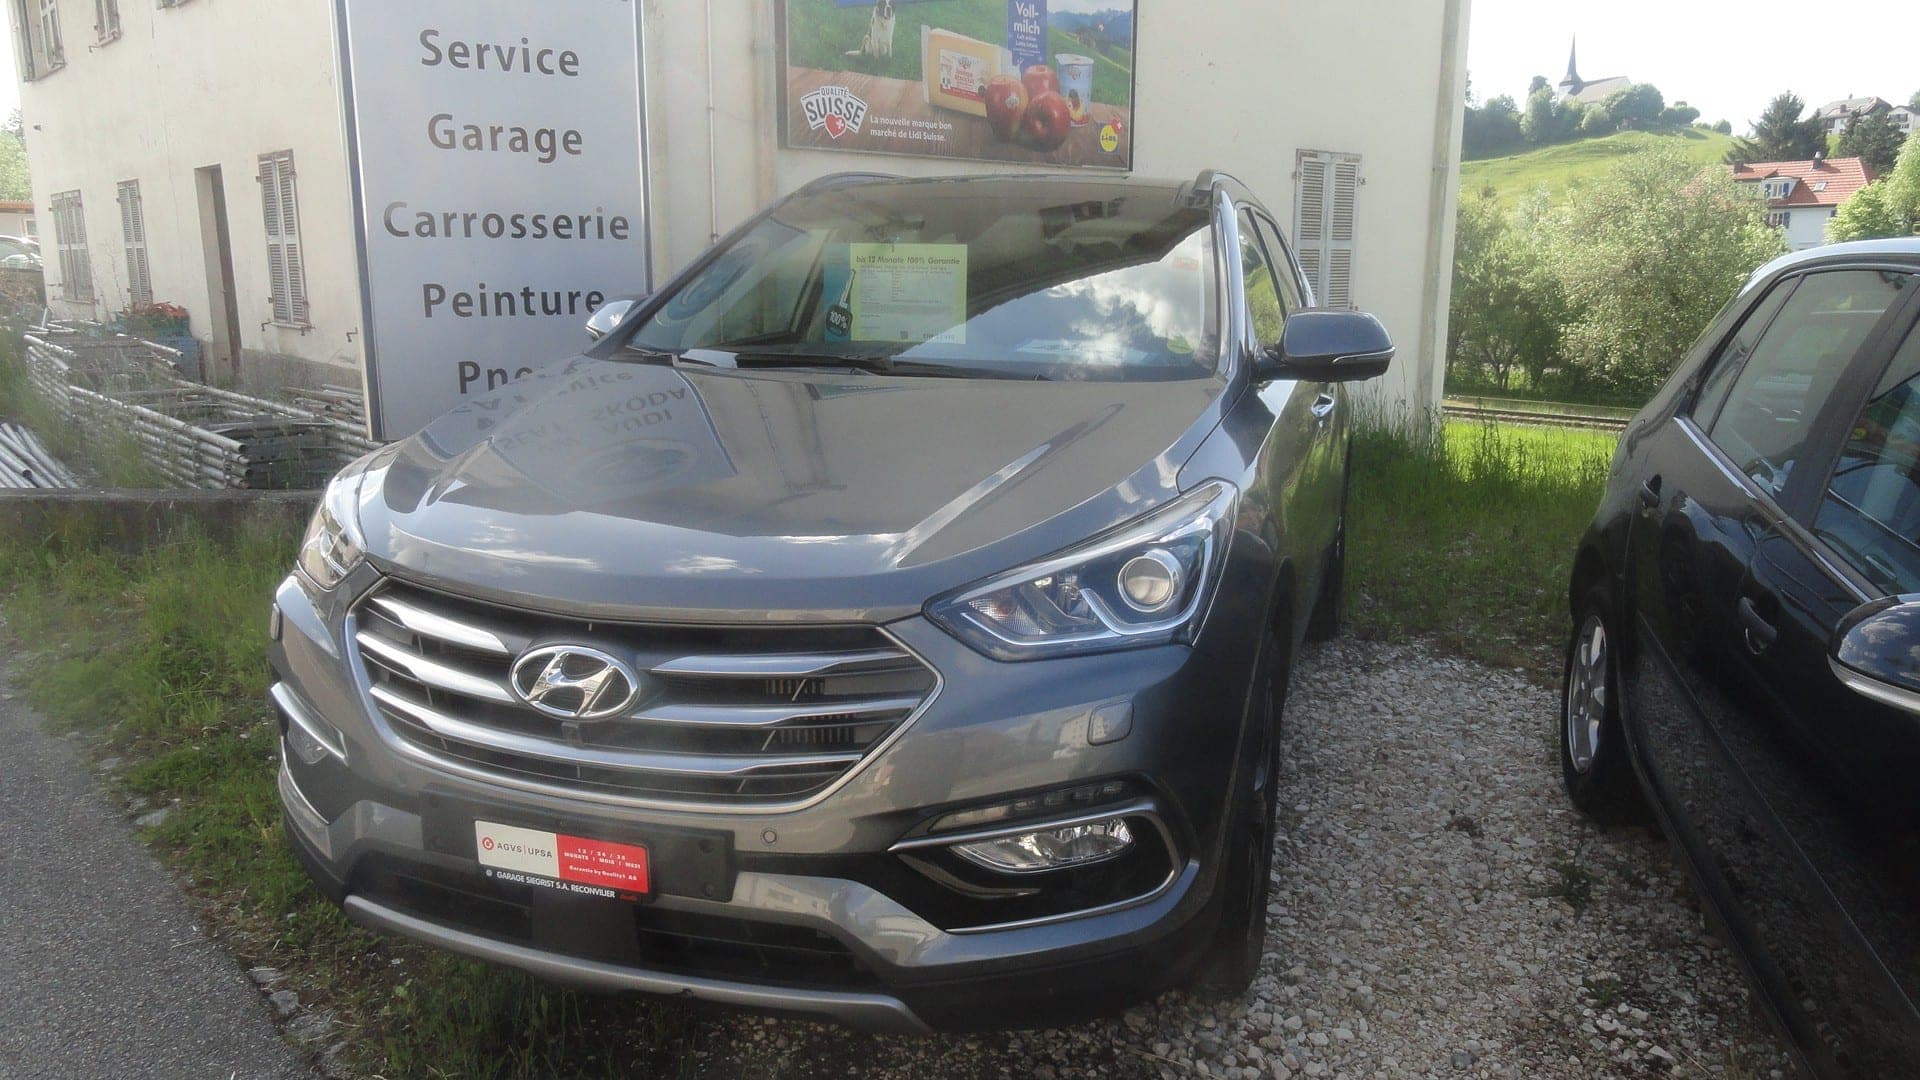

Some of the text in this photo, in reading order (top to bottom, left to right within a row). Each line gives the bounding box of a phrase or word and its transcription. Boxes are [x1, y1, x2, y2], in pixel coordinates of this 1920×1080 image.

[1015, 1, 1040, 19] Voll-
[1013, 18, 1040, 35] milch
[419, 29, 579, 77] Service
[821, 87, 849, 97] QUALITÉ
[805, 97, 864, 127] SUISSE
[870, 116, 953, 131] La nouvelle marque bon
[427, 113, 584, 163] Garage
[870, 127, 897, 138] marché
[898, 129, 907, 138] de
[908, 129, 922, 140] Lidl
[383, 202, 630, 241] Carrosserie
[928, 257, 961, 265] Garantie
[423, 283, 605, 318] Peinture
[829, 311, 848, 329] 100%
[497, 842, 553, 859] AGVS UPSA
[496, 871, 525, 883] GARAGE
[526, 876, 555, 889] SIEGRIST
